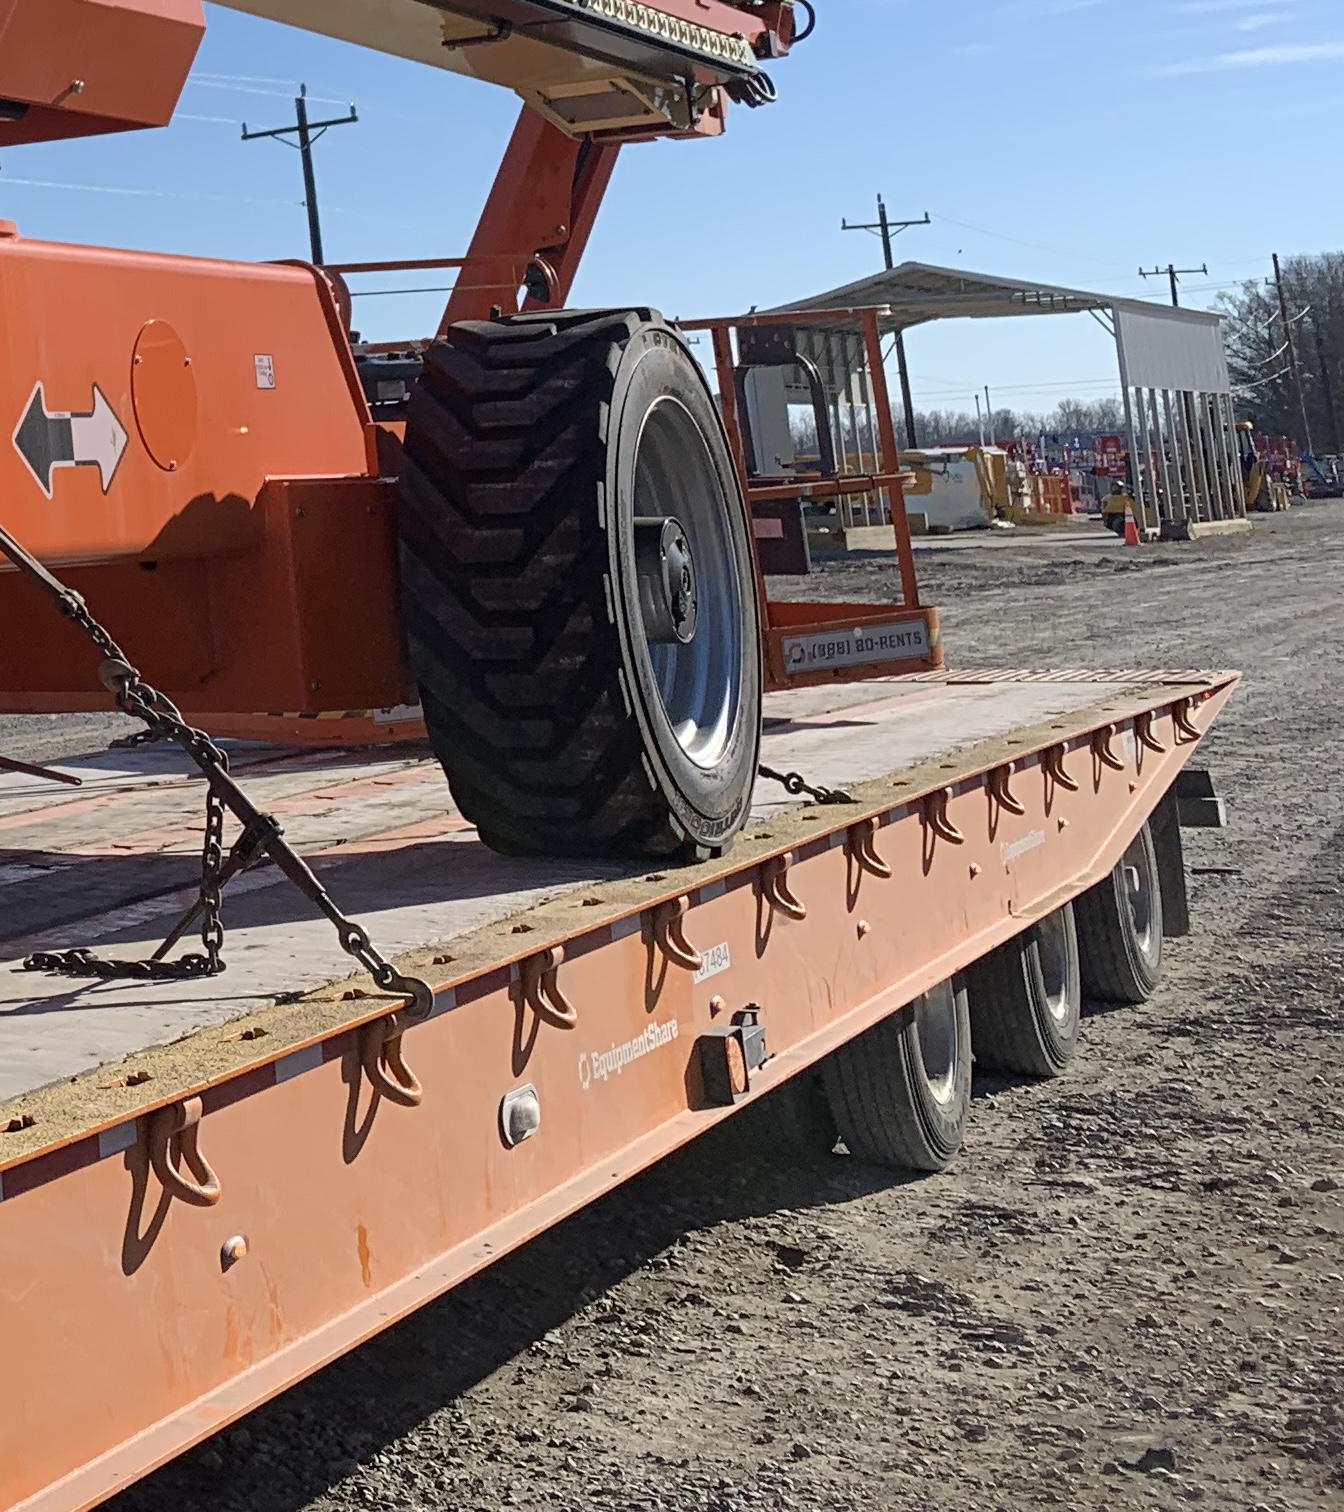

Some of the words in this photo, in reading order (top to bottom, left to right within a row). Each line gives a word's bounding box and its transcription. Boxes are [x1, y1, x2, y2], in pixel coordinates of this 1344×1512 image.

[855, 631, 923, 652] 80-RENTS
[695, 943, 729, 978] 7484
[590, 1018, 680, 1082] EquipmentShare
